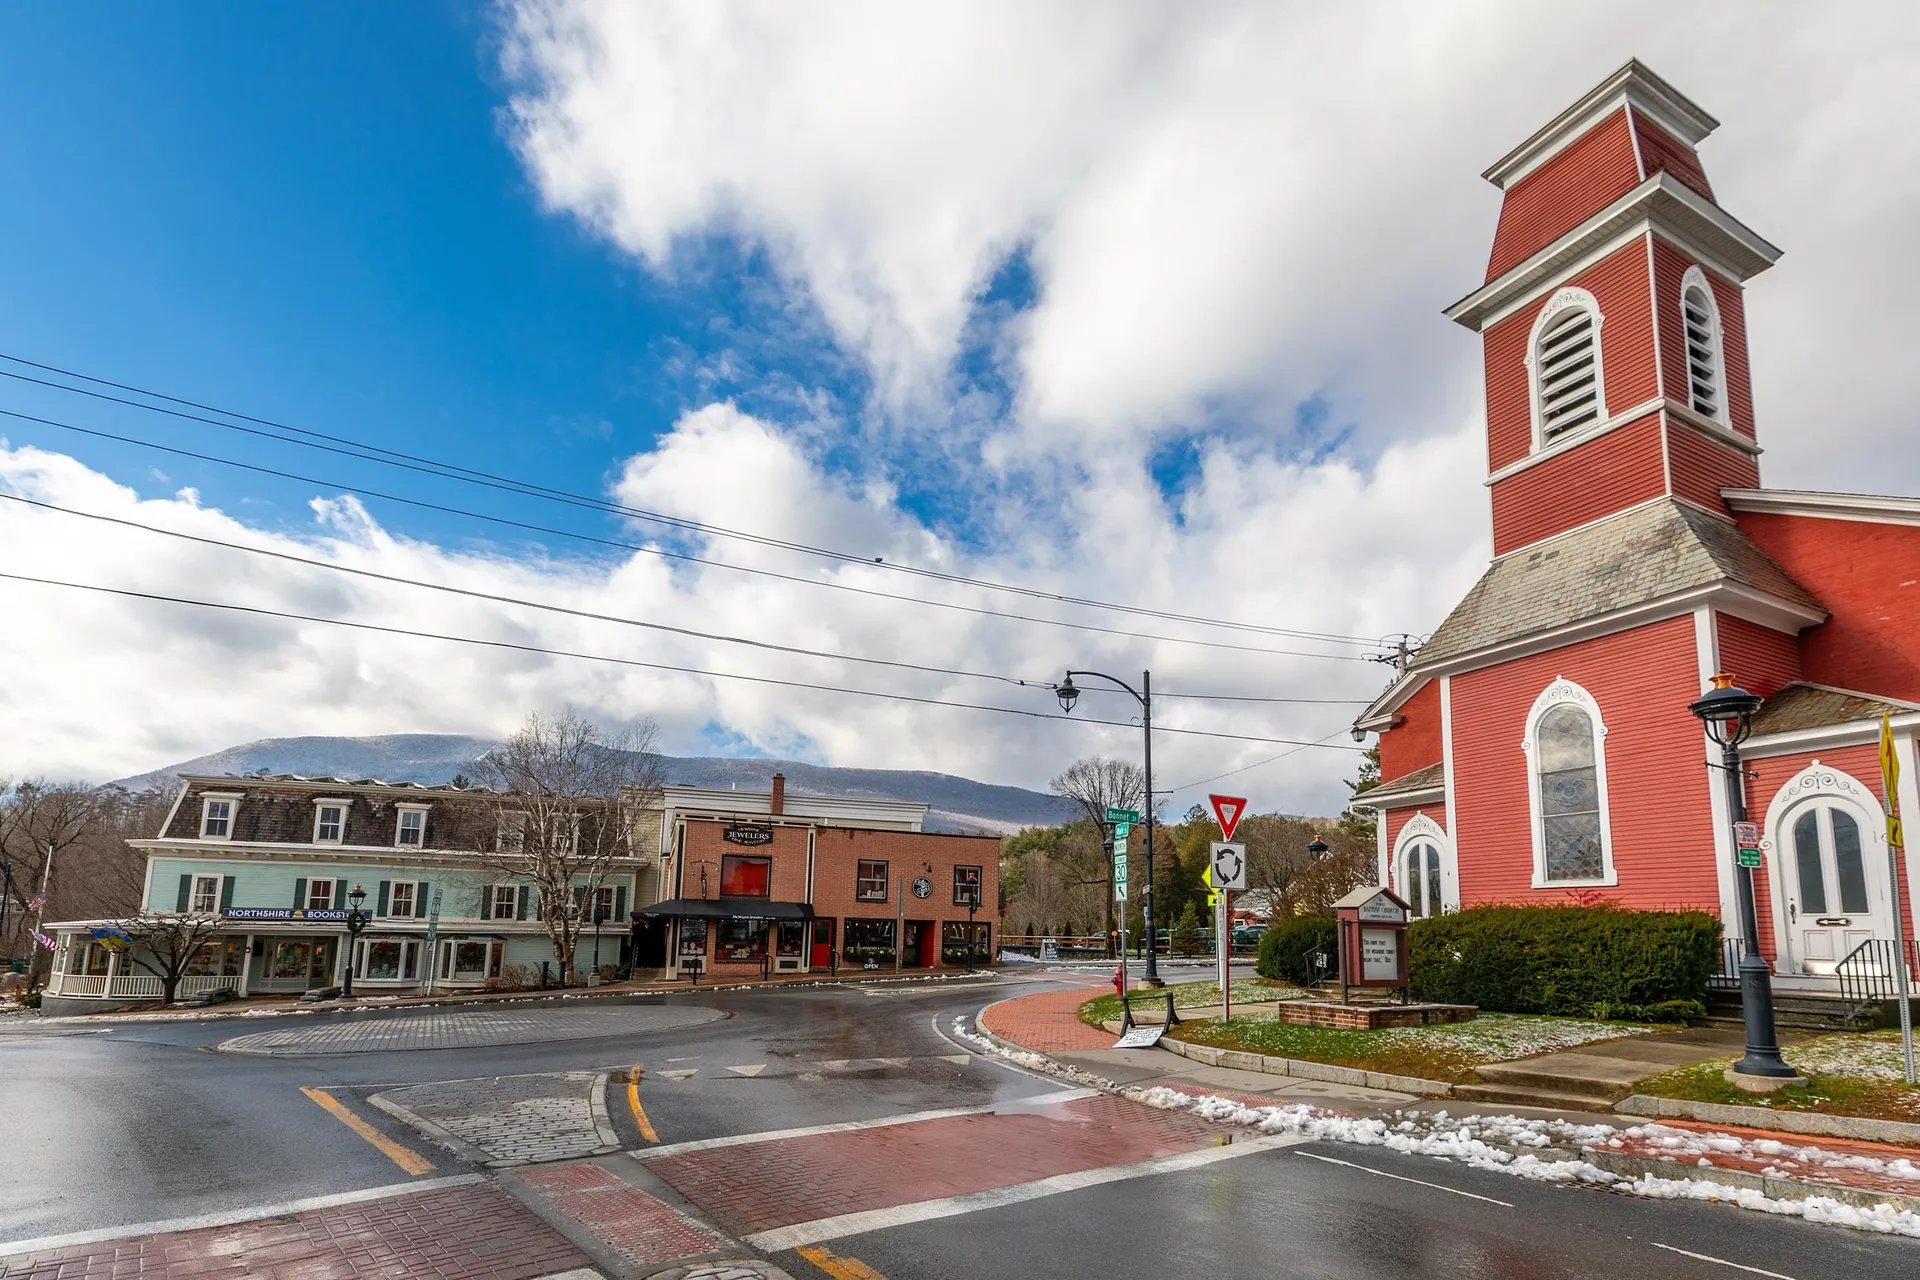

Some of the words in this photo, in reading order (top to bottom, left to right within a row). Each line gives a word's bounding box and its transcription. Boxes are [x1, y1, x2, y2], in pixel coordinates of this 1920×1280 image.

[1108, 811, 1130, 820] Bonnet
[727, 831, 770, 840] JEWELERS
[1116, 865, 1126, 879] 30
[228, 909, 291, 918] NORTHSHIRE
